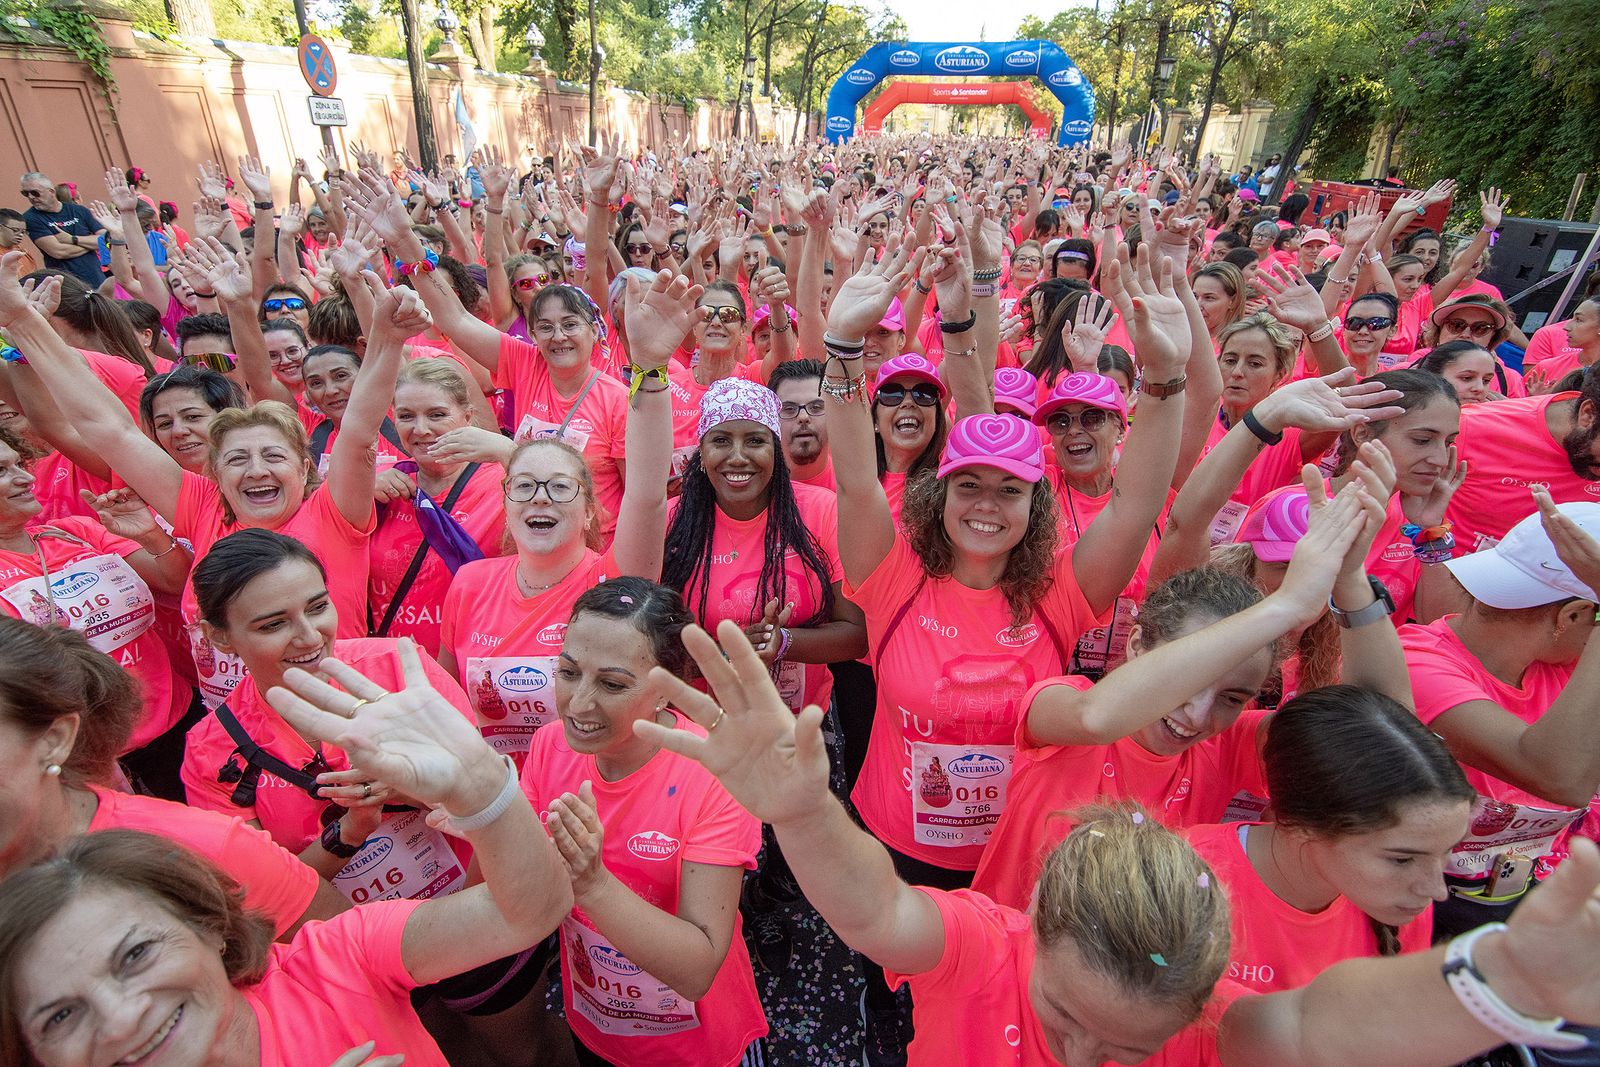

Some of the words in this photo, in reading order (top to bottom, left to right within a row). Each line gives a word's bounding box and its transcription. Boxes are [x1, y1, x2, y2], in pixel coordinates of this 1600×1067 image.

[940, 54, 985, 66] ASTURIANA
[933, 88, 951, 96] Sports
[959, 88, 988, 96] Santander
[315, 102, 331, 110] ZONA
[53, 576, 97, 597] ASTURIANA
[68, 593, 110, 618] 016
[85, 610, 110, 627] 3035
[86, 627, 97, 637] DE
[99, 624, 109, 633] LA
[110, 615, 132, 629] MUJER
[121, 620, 149, 639] Santander
[918, 615, 958, 638] OYSHO
[218, 660, 249, 676] 016
[502, 676, 544, 686] ASTURIANA
[508, 700, 547, 713] 016
[523, 716, 542, 725] 935
[898, 705, 932, 737] TU
[493, 738, 529, 748] OYSHO
[952, 764, 1001, 774] ASTURIANA
[956, 786, 998, 801] 016
[964, 803, 991, 815] 5766
[394, 813, 419, 834] SUMA
[928, 816, 963, 825] CARRERA
[1510, 818, 1557, 829] 016
[926, 828, 964, 840] OYSHO
[631, 839, 676, 854] ASTURIANA
[1456, 854, 1490, 867] OYSHO
[351, 867, 404, 904] 016
[432, 875, 450, 891] 2023
[386, 890, 402, 901] 61
[593, 950, 640, 971] ASTURIANA
[1228, 961, 1274, 983] SHO
[597, 975, 642, 999] 016
[581, 991, 607, 1013] CARRERA
[608, 1008, 619, 1016] DE
[620, 1010, 631, 1018] LA
[632, 1012, 660, 1021] MUJER
[607, 997, 636, 1009] 2962
[581, 1002, 610, 1028] OYSHO
